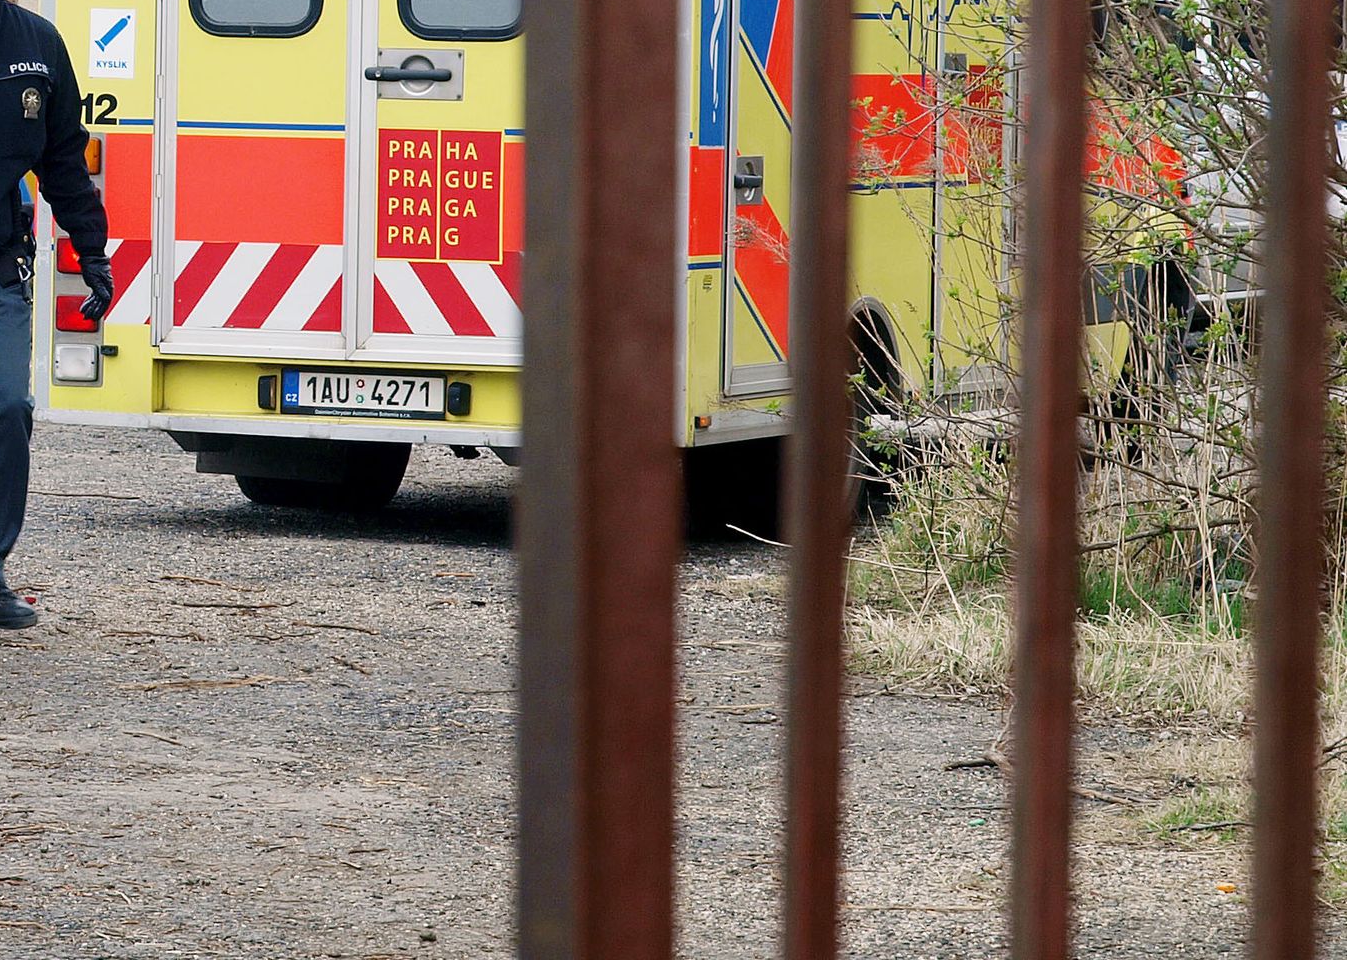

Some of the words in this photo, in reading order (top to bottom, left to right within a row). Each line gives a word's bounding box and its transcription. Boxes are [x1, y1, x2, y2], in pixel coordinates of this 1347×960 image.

[96, 59, 128, 69] KYSLÍK
[388, 140, 433, 159] PRA
[446, 141, 479, 161] HA
[388, 168, 433, 188] PRA
[445, 170, 494, 190] GUE
[388, 197, 432, 216] PRA
[444, 198, 478, 218] GA
[387, 225, 432, 245] PRA
[444, 227, 460, 246] G
[285, 393, 298, 403] CZ
[306, 376, 350, 404] 1AU
[370, 379, 431, 407] 4271
